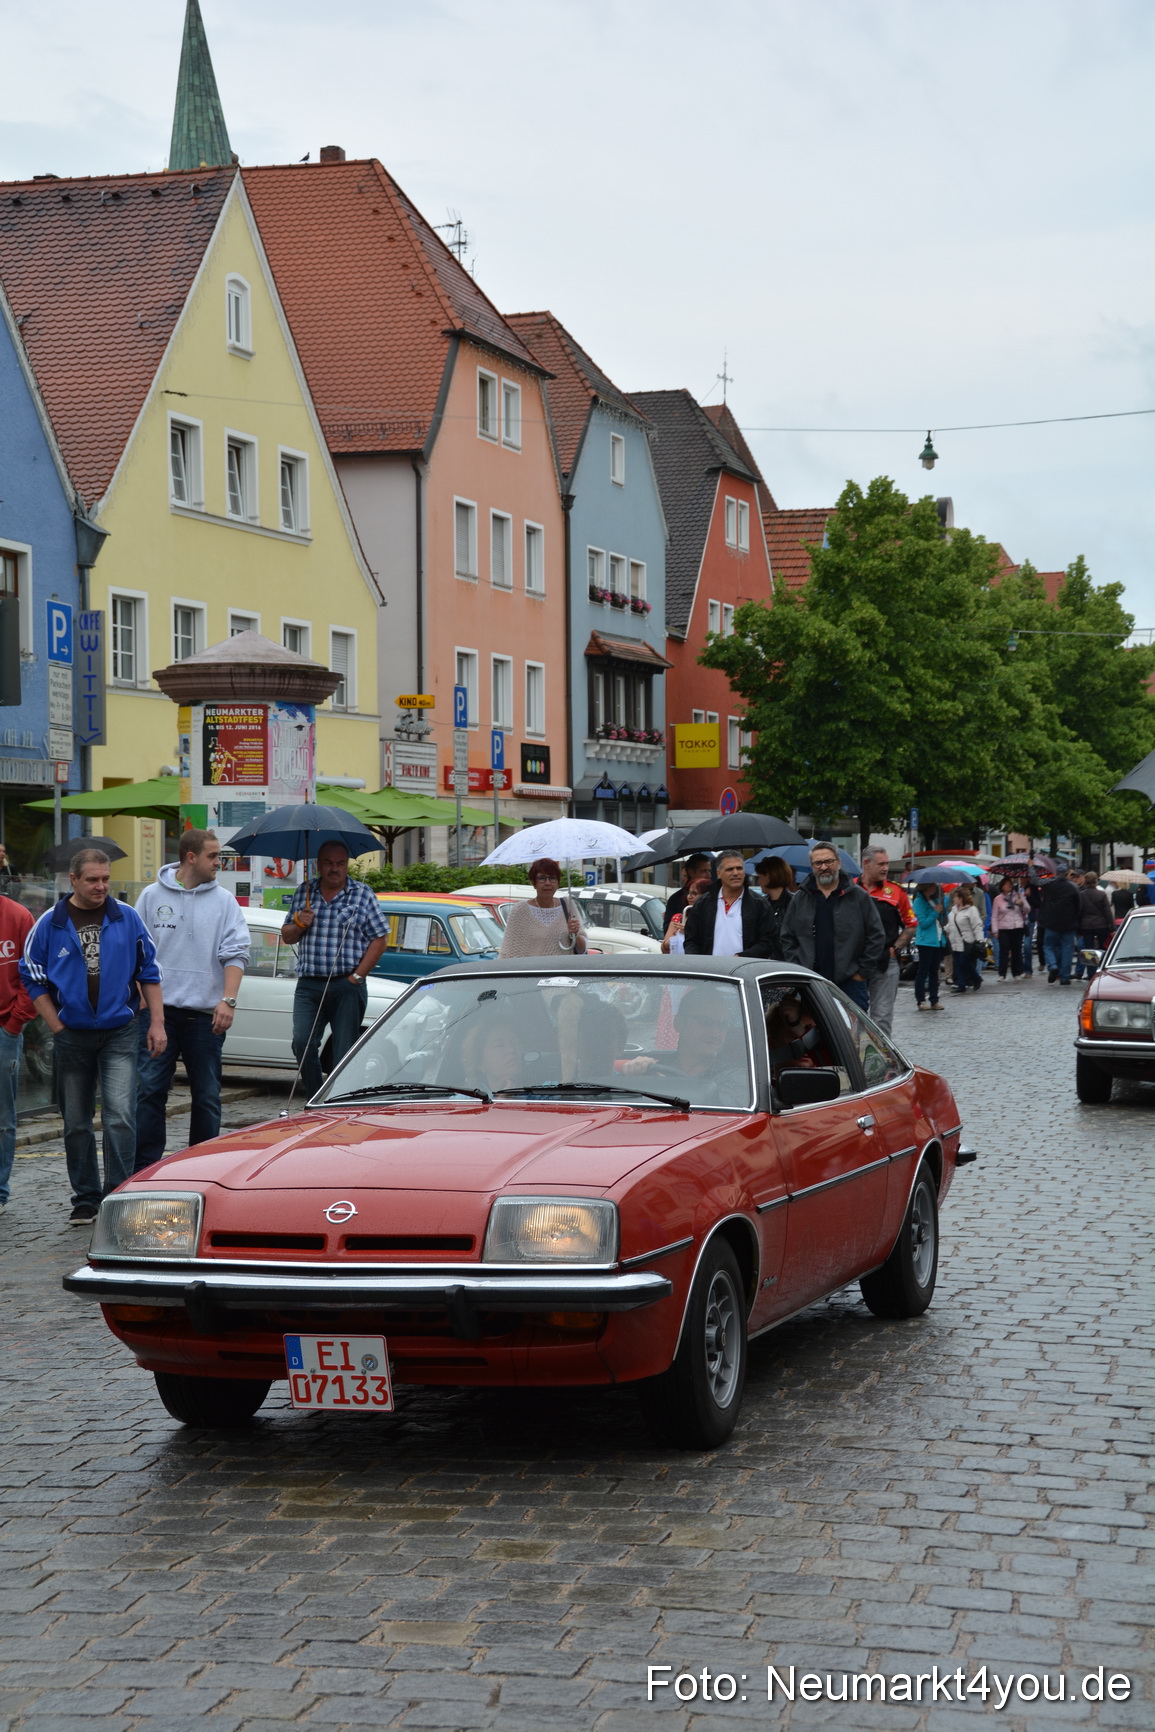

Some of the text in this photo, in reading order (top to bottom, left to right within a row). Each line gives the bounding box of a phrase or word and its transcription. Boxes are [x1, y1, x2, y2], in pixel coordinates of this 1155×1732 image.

[52, 609, 67, 654] P
[80, 634, 99, 731] WITTL
[205, 708, 264, 716] NEUMARKTER
[399, 697, 417, 706] KINO
[457, 691, 465, 723] P
[205, 715, 264, 724] ALTSTADTFEST
[493, 735, 502, 765] P
[291, 1356, 299, 1365] D
[316, 1341, 356, 1371] EI
[292, 1373, 389, 1405] 07133
